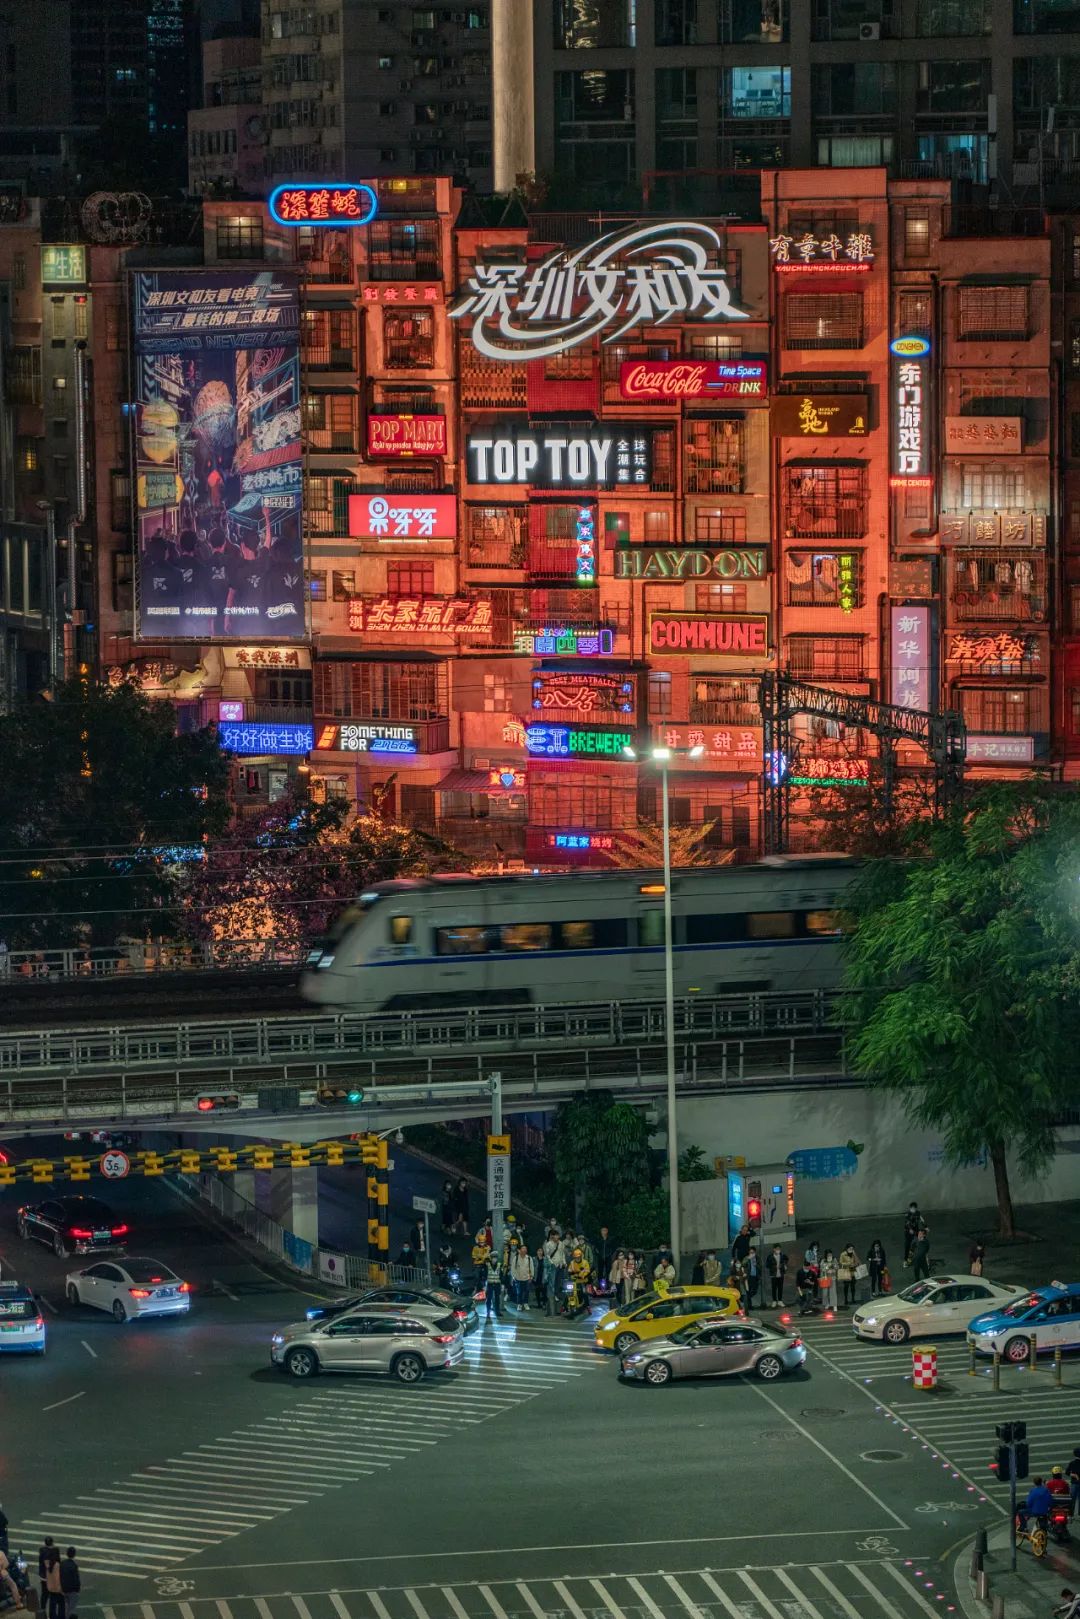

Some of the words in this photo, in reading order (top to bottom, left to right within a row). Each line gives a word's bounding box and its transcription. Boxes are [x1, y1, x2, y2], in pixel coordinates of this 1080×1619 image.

[719, 366, 736, 375] Time
[737, 366, 762, 378] Space
[723, 382, 761, 393] DRINK
[898, 362, 922, 474] 东门游戏厅
[370, 420, 400, 441] POP
[403, 420, 445, 441] MART
[617, 440, 647, 451] 全球
[470, 439, 538, 481] TOP
[544, 439, 612, 481] TOY
[617, 454, 647, 466] 潮玩
[617, 469, 647, 480] 集合
[616, 550, 764, 577] HAYDON
[538, 627, 573, 637] SEASON
[652, 620, 765, 650] COMMUNE
[571, 676, 617, 688] MEATBALLS
[341, 725, 414, 740] SOMETHING
[341, 738, 367, 751] FOR
[569, 732, 631, 754] BREWERY
